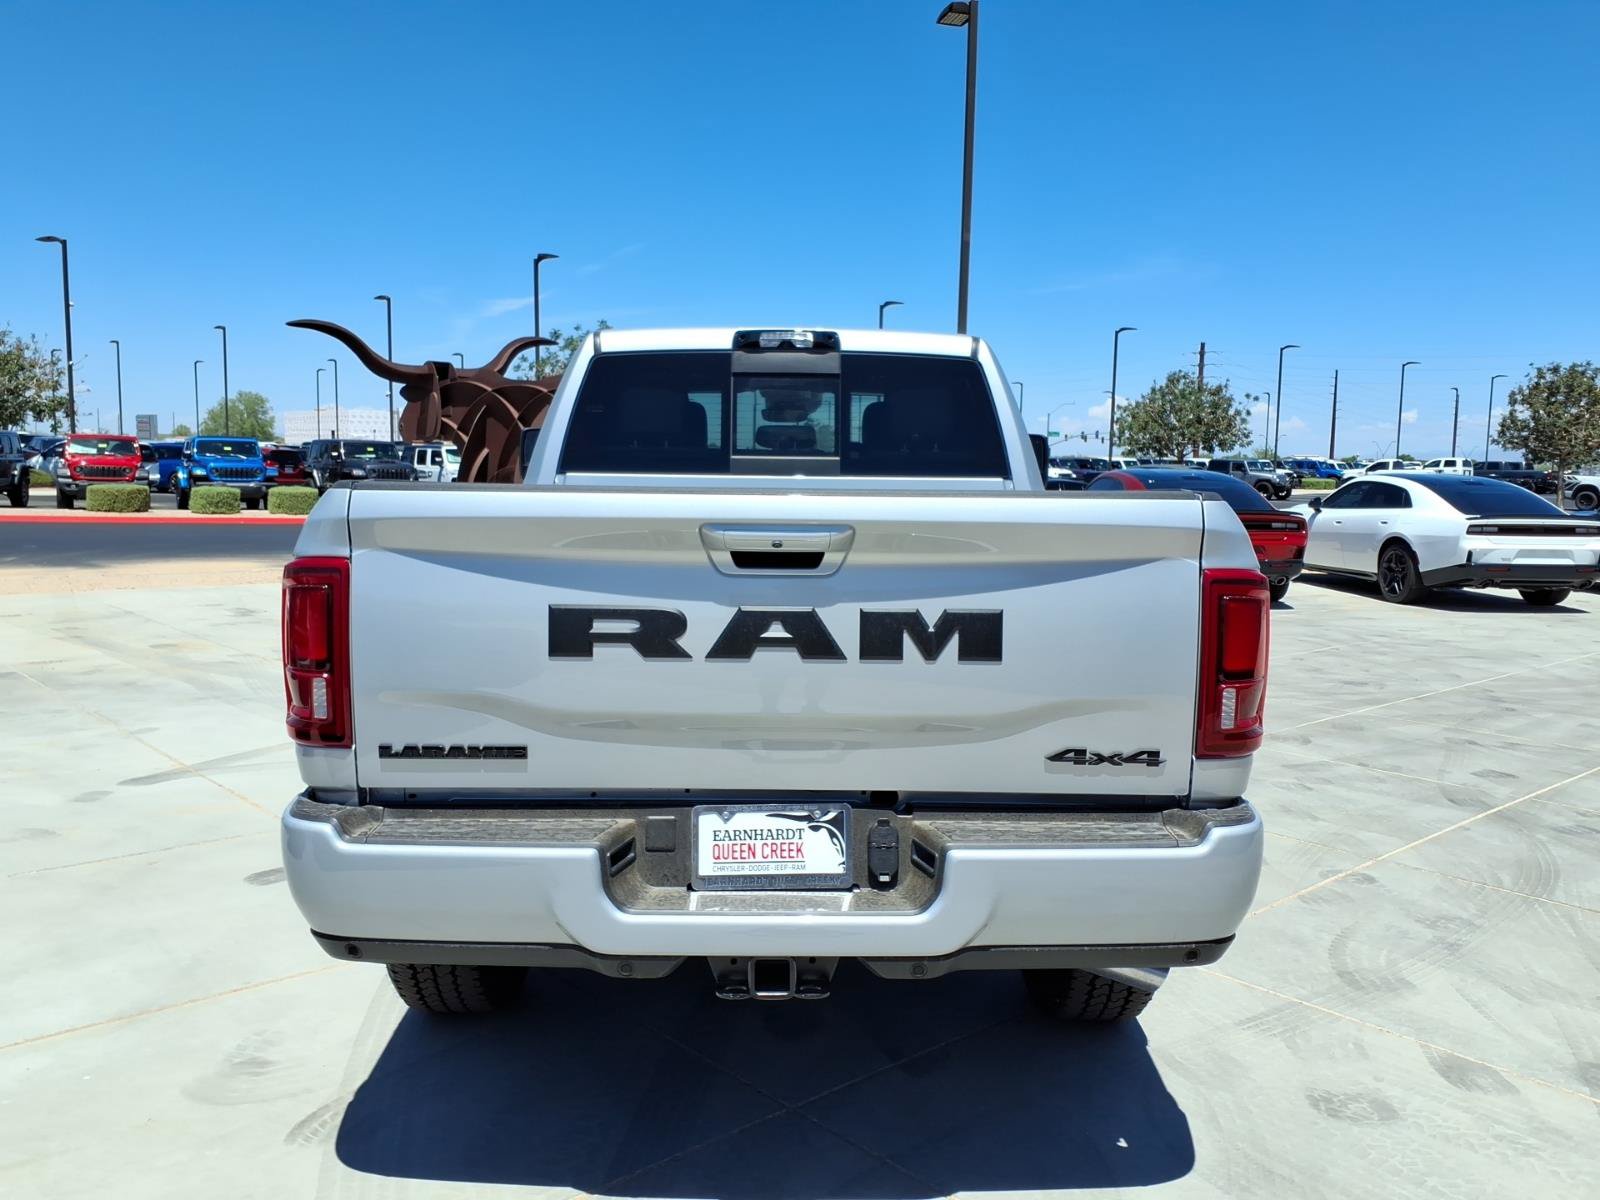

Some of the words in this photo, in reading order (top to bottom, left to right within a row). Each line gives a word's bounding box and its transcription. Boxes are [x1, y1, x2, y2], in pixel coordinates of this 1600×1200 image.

[548, 604, 1003, 662] RAM
[1045, 748, 1167, 767] 4x4
[712, 828, 805, 842] EARNHARDT
[712, 843, 756, 860] QUEEN
[761, 842, 805, 859] CREEK
